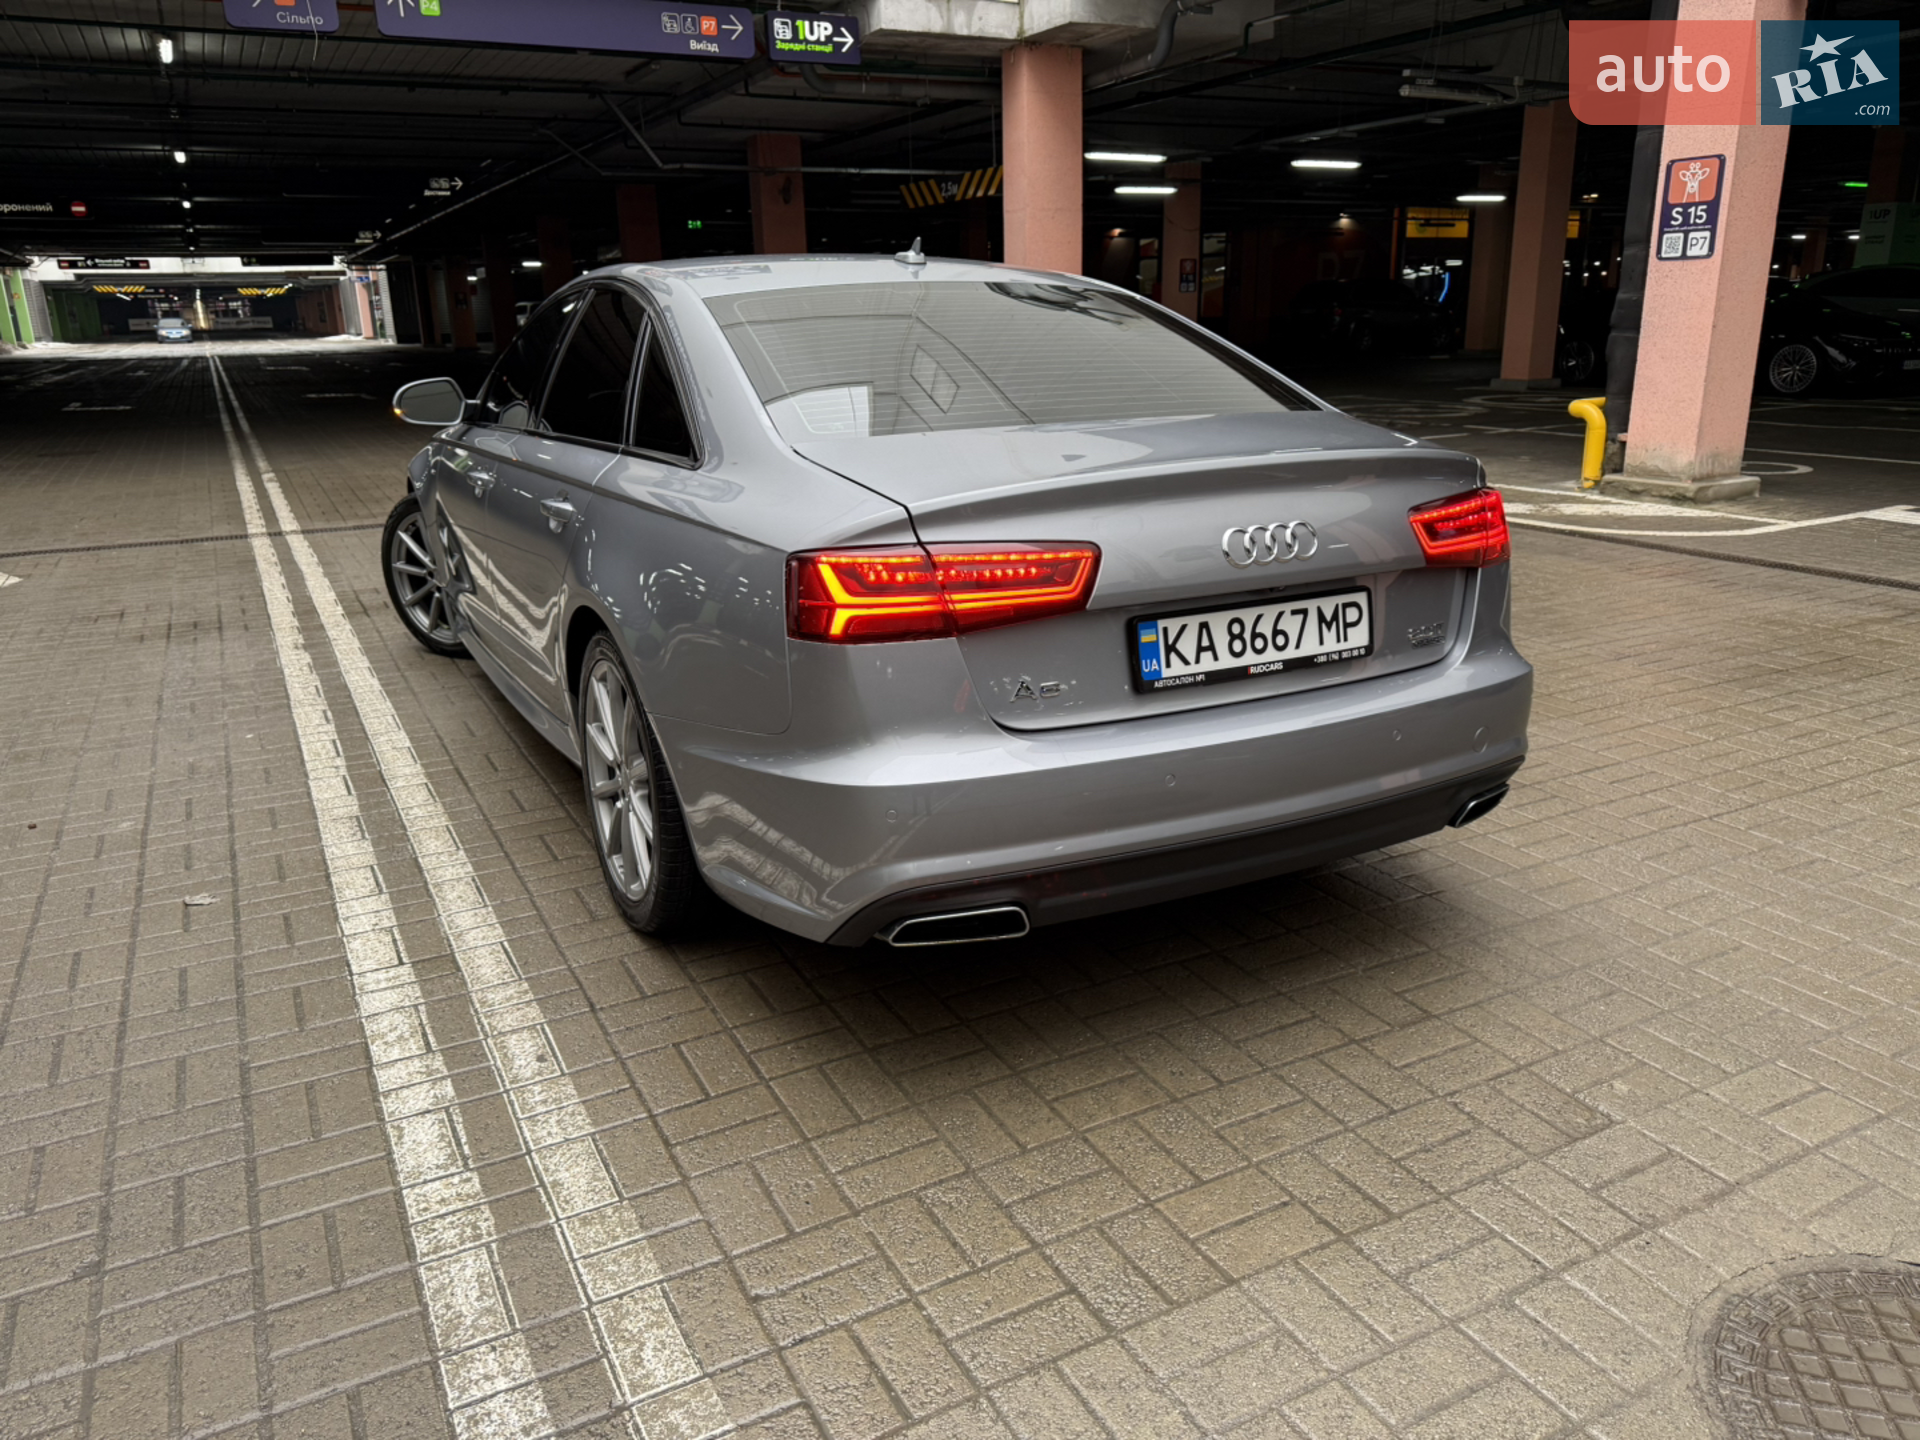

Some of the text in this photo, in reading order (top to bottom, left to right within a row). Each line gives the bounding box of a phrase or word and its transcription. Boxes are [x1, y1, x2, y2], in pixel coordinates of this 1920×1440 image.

[276, 11, 324, 25] Сільпо
[702, 20, 716, 32] P7
[795, 19, 833, 42] 1UP
[689, 39, 719, 53] Виїзд
[1670, 205, 1708, 226] S 15
[1688, 236, 1708, 252] P7
[1162, 601, 1364, 669] KA 8667 MP
[1142, 658, 1160, 673] UA
[1250, 662, 1283, 675] RUDCARS
[1153, 676, 1195, 688] АВТОСАЛОН
